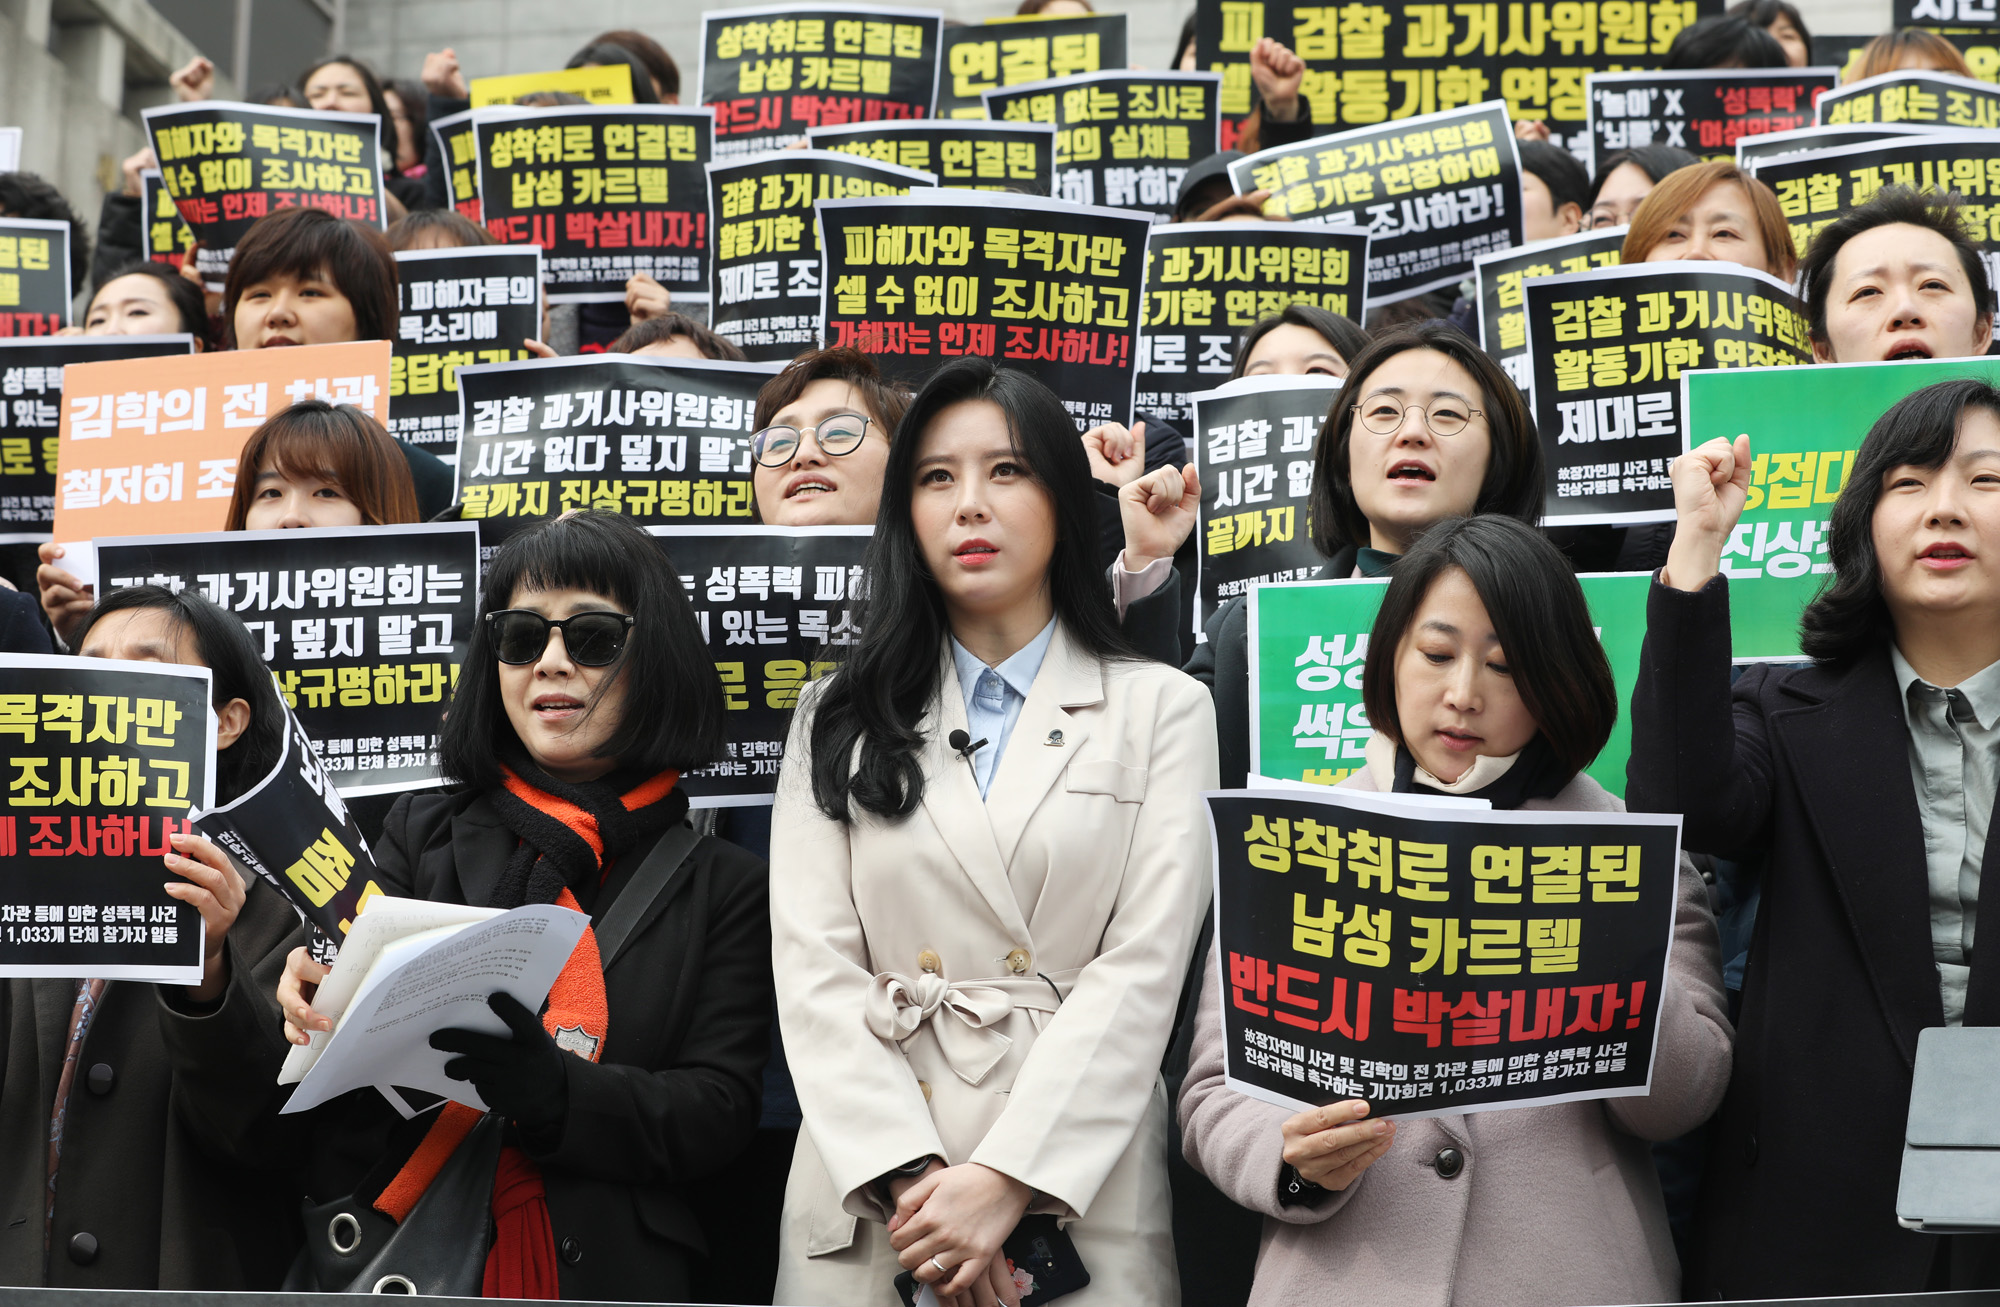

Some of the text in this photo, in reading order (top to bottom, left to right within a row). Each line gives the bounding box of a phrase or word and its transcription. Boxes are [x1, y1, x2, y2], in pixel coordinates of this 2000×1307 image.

[717, 20, 923, 59] 성착취로 연결된
[1293, 0, 1697, 60] 검찰 과거사위원회
[738, 57, 892, 95] 남성 카르텔
[1063, 86, 1120, 124] 없는
[1128, 84, 1206, 120] 조사로
[1662, 88, 1684, 116] X
[1880, 85, 1939, 120] 없는
[252, 124, 363, 163] 목격자만
[490, 125, 595, 168] 성착취로
[603, 124, 697, 161] 연결된
[1110, 124, 1191, 160] 실체를
[1315, 119, 1494, 177] 과거사위원회
[1665, 120, 1687, 148] X
[199, 157, 252, 193] 없이
[261, 158, 374, 195] 조사하고
[941, 140, 1036, 179] 연결된
[1380, 146, 1502, 196] 연장하여
[222, 192, 268, 221] 언제
[511, 167, 669, 208] 남성 카르텔
[721, 177, 758, 218] 검찰
[1776, 172, 1842, 218] 검찰
[565, 211, 706, 249] 박살내자!
[1366, 183, 1505, 241] 조사하라!
[719, 215, 805, 260] 활동기한
[843, 224, 975, 267] 피해자와
[983, 226, 1127, 279] 목격자만
[718, 260, 780, 305] 제대로
[1160, 245, 1350, 286] 과거사위원회
[410, 276, 535, 312] 피해자들의
[834, 274, 1129, 328] 셀 수 없이 조사하고
[399, 310, 498, 345] 목소리에
[1551, 295, 1627, 342] 검찰
[829, 320, 1129, 368] 가해자는 언제 조사하냐!
[1552, 337, 1704, 391] 활동기한
[13, 400, 59, 428] 있는
[68, 382, 270, 441] 김학의 전
[473, 396, 536, 437] 검찰
[1088, 402, 1112, 418] 사건
[1135, 392, 1159, 406] 사건
[1557, 391, 1677, 445] 제대로
[470, 438, 535, 479] 시간
[544, 435, 611, 474] 없다
[619, 434, 686, 473] 덮지
[1208, 419, 1273, 466] 검찰
[61, 465, 183, 511] 철저히
[1213, 463, 1278, 511] 시간
[1556, 474, 1673, 498] 진상규명을 촉구하는
[1622, 460, 1648, 477] 사건
[1650, 458, 1664, 474] 및
[460, 480, 550, 520] 끝까지
[1207, 506, 1295, 556] 끝까지
[197, 564, 463, 612] 과거사위원회는
[705, 566, 802, 602] 성폭력
[291, 612, 455, 660] 덮지 말고
[721, 610, 788, 646] 있는
[0, 694, 183, 749] 목격자만
[327, 738, 354, 755] 등에
[356, 737, 383, 753] 의한
[386, 735, 426, 752] 성폭력
[357, 751, 426, 770] 단체 참가자
[8, 754, 191, 809] 조사하고
[1243, 814, 1643, 905] 성착취로 연결된
[1, 904, 177, 925] 차관 등에 의한 성폭력 사건
[6, 925, 179, 945] 1,033개 단체 참가자 일동
[1292, 891, 1583, 977] 남성 카르텔
[1228, 950, 1648, 1049] 반드시 박살내자!
[1243, 1027, 1628, 1080] 故장자연씨 사건 및 김학의 전 차관 등에 의한 성폭력 사건
[1244, 1046, 1628, 1101] 진상규명을 촉구하는 기자회견 1,033개 단체 참가자 일동
